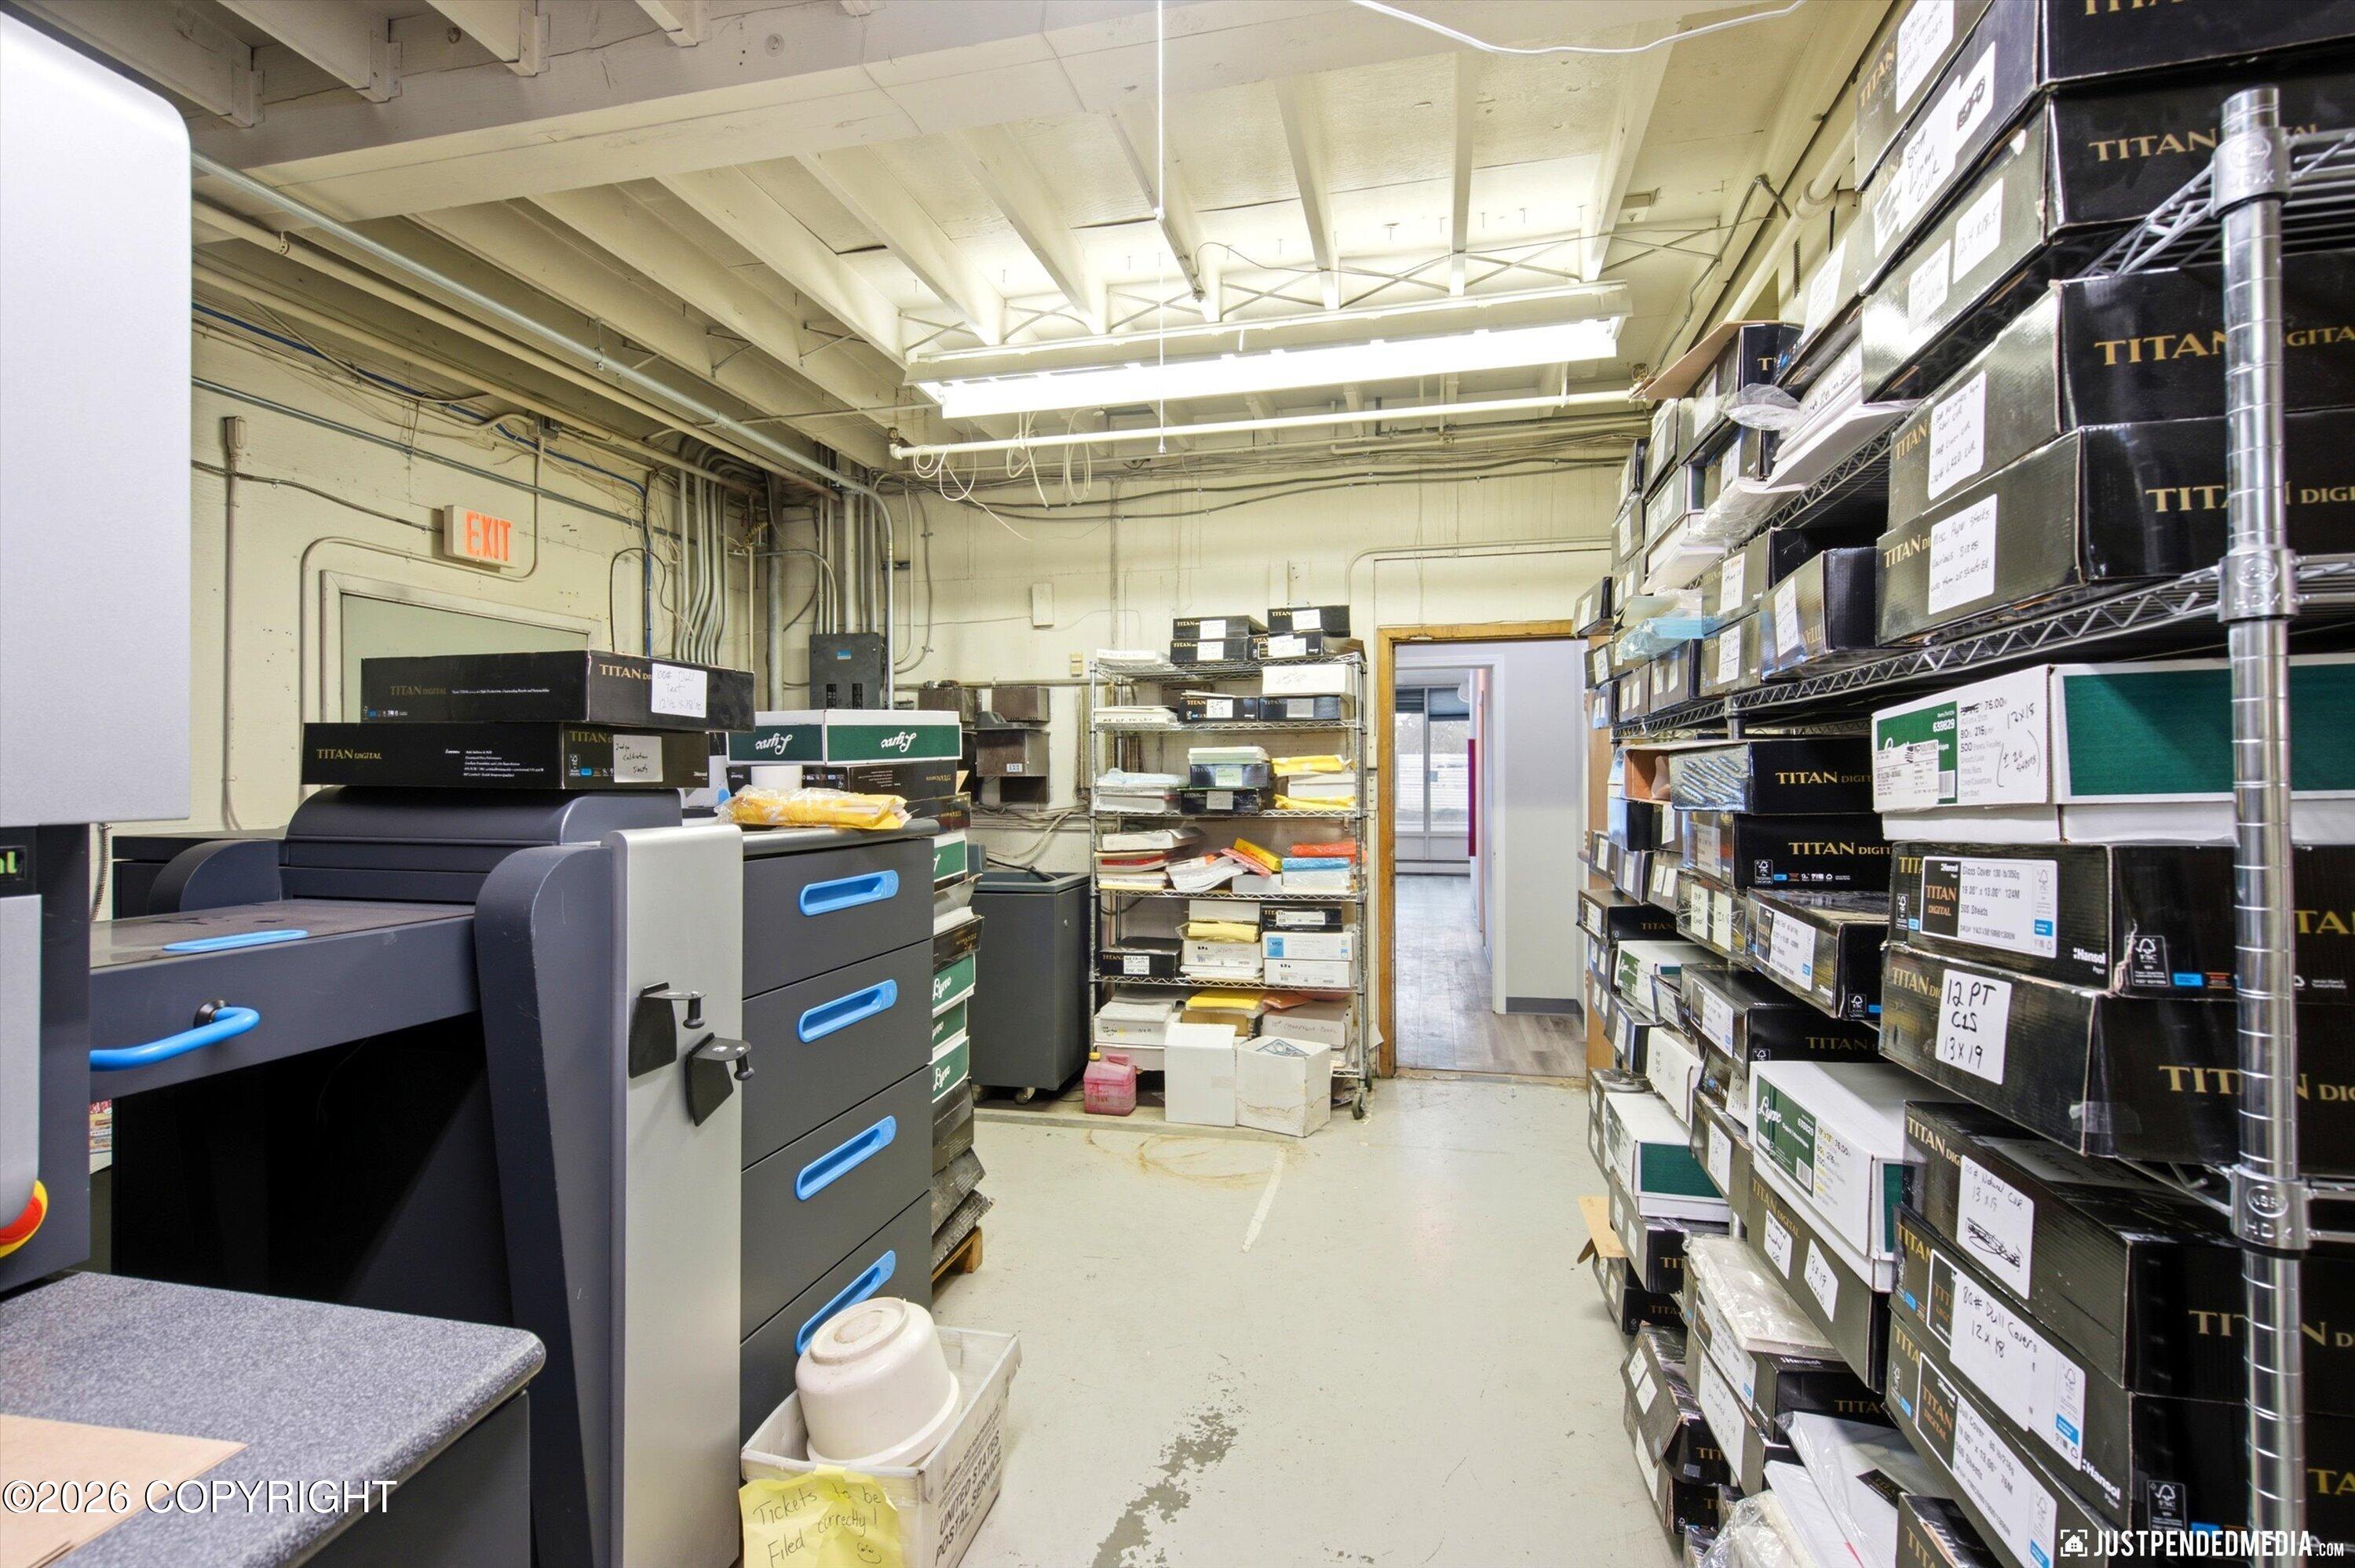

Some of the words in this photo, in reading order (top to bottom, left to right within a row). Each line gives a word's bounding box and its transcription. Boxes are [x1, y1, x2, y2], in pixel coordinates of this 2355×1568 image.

[2089, 128, 2217, 162] TITAN
[2285, 326, 2355, 346] GITA
[1895, 419, 1929, 461] TITAN
[2145, 481, 2290, 512] TIT
[2300, 486, 2355, 505] DIGI
[466, 510, 511, 562] EXIT
[1884, 534, 1921, 569] TITAN
[599, 663, 641, 680] TITAN
[389, 684, 422, 696] TITAN
[569, 731, 607, 744] TITAN
[755, 732, 793, 755] Lynx
[881, 731, 917, 753] Lynx
[317, 749, 353, 759] TITAN
[353, 751, 382, 760] DIGITAL
[1775, 771, 1838, 785] TITAN
[1788, 842, 1855, 855] TITAN
[1857, 846, 1893, 855] DIGIT
[1898, 856, 1923, 874] TIT
[1926, 885, 1957, 902] TITAN
[1928, 905, 1952, 917] DIGITAL
[2078, 948, 2106, 965] Hansol
[1892, 967, 1930, 995] TITAN
[1947, 979, 1964, 1007] 12
[1969, 982, 1997, 1007] PT
[1806, 1036, 1868, 1051] TITAN
[1907, 1116, 1945, 1157] TITAN
[1752, 1178, 1777, 1214] TITAN
[1776, 1210, 1800, 1238] DIGITAL
[1897, 1221, 1933, 1264] TITAN
[1962, 1285, 1983, 1310] 80#
[1894, 1325, 1920, 1368] TITA
[1834, 1399, 1881, 1413] TITA
[1922, 1384, 1953, 1431] TITAN
[1924, 1410, 1947, 1442] DIGITAL
[940, 1476, 971, 1536] UNITED
[973, 1429, 1000, 1485] STATES
[2086, 1462, 2120, 1500] Hansol
[753, 1488, 817, 1526] Tickets
[862, 1486, 881, 1504] be
[934, 1501, 970, 1567] POSTAL
[971, 1444, 1002, 1508] SERVICE
[767, 1529, 805, 1568] Filed
